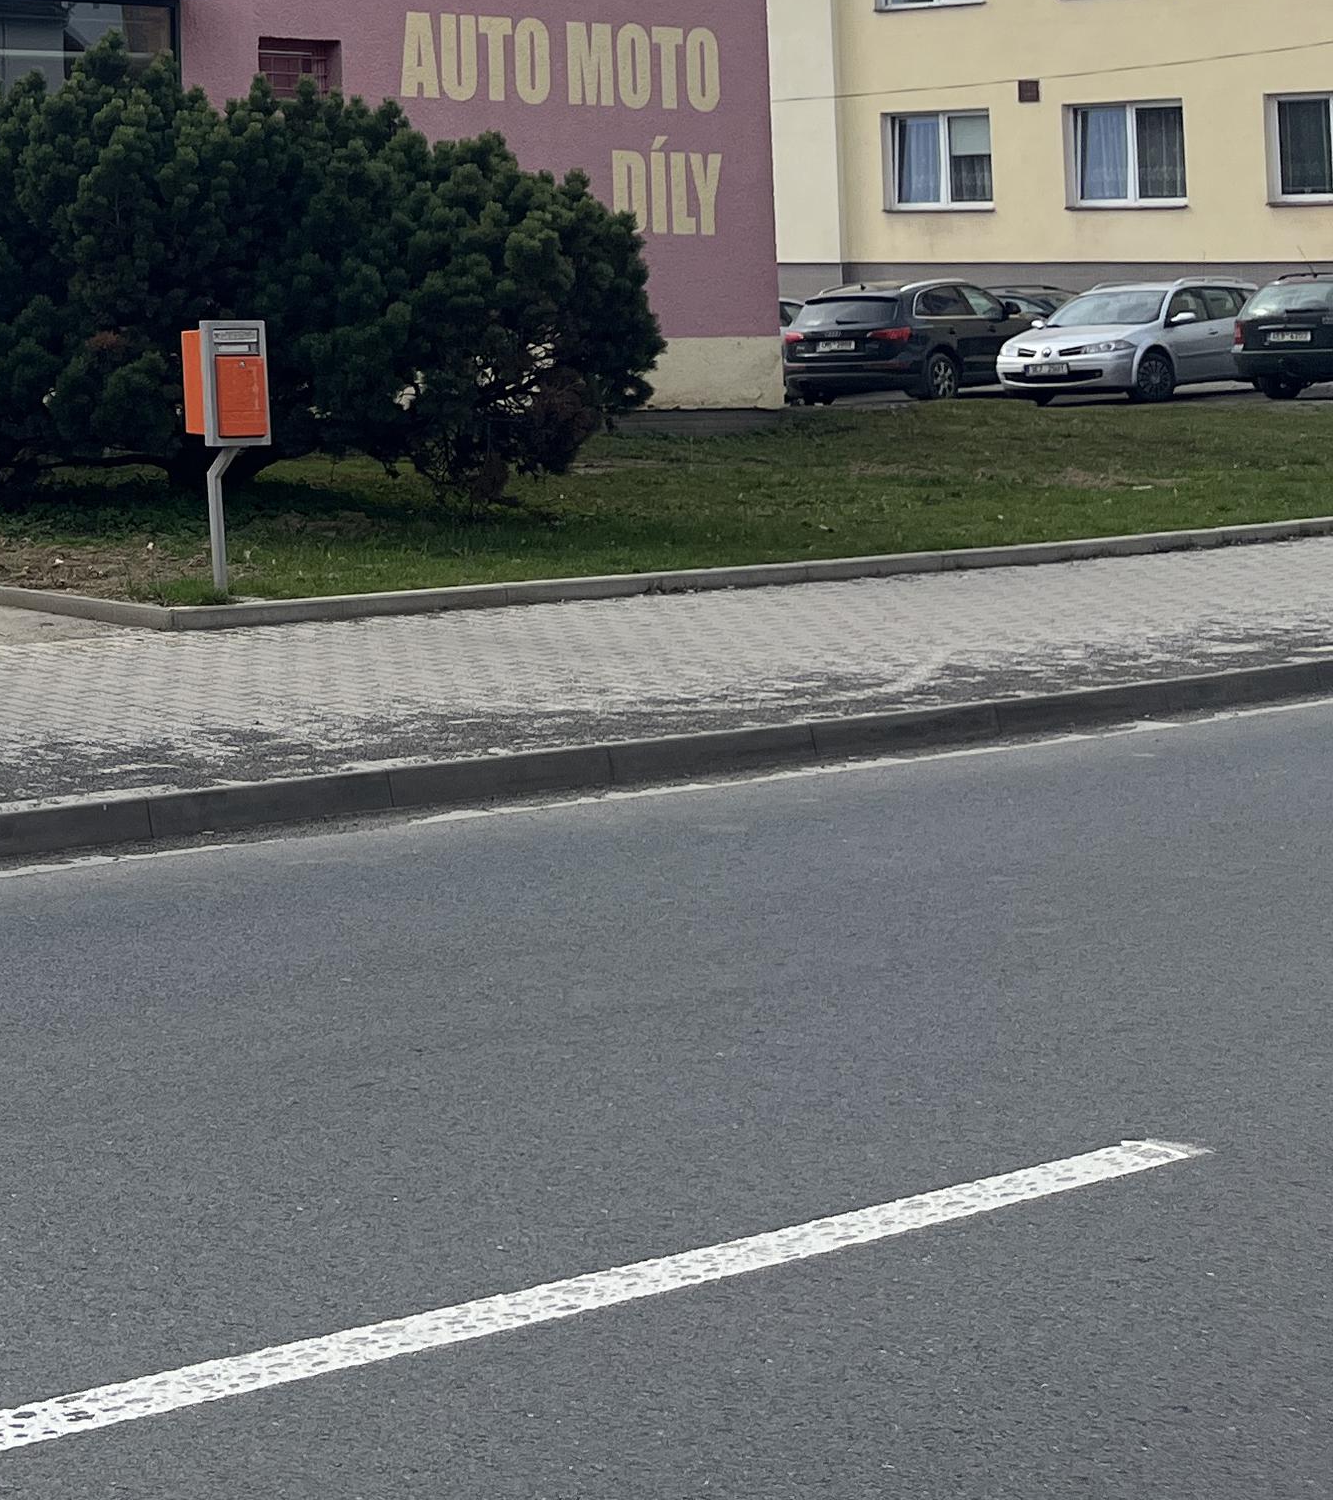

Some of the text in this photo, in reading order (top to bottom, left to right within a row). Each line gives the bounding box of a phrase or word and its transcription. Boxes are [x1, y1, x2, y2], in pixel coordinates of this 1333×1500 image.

[399, 10, 721, 113] AUTO MOTO
[611, 134, 723, 236] DÍLY
